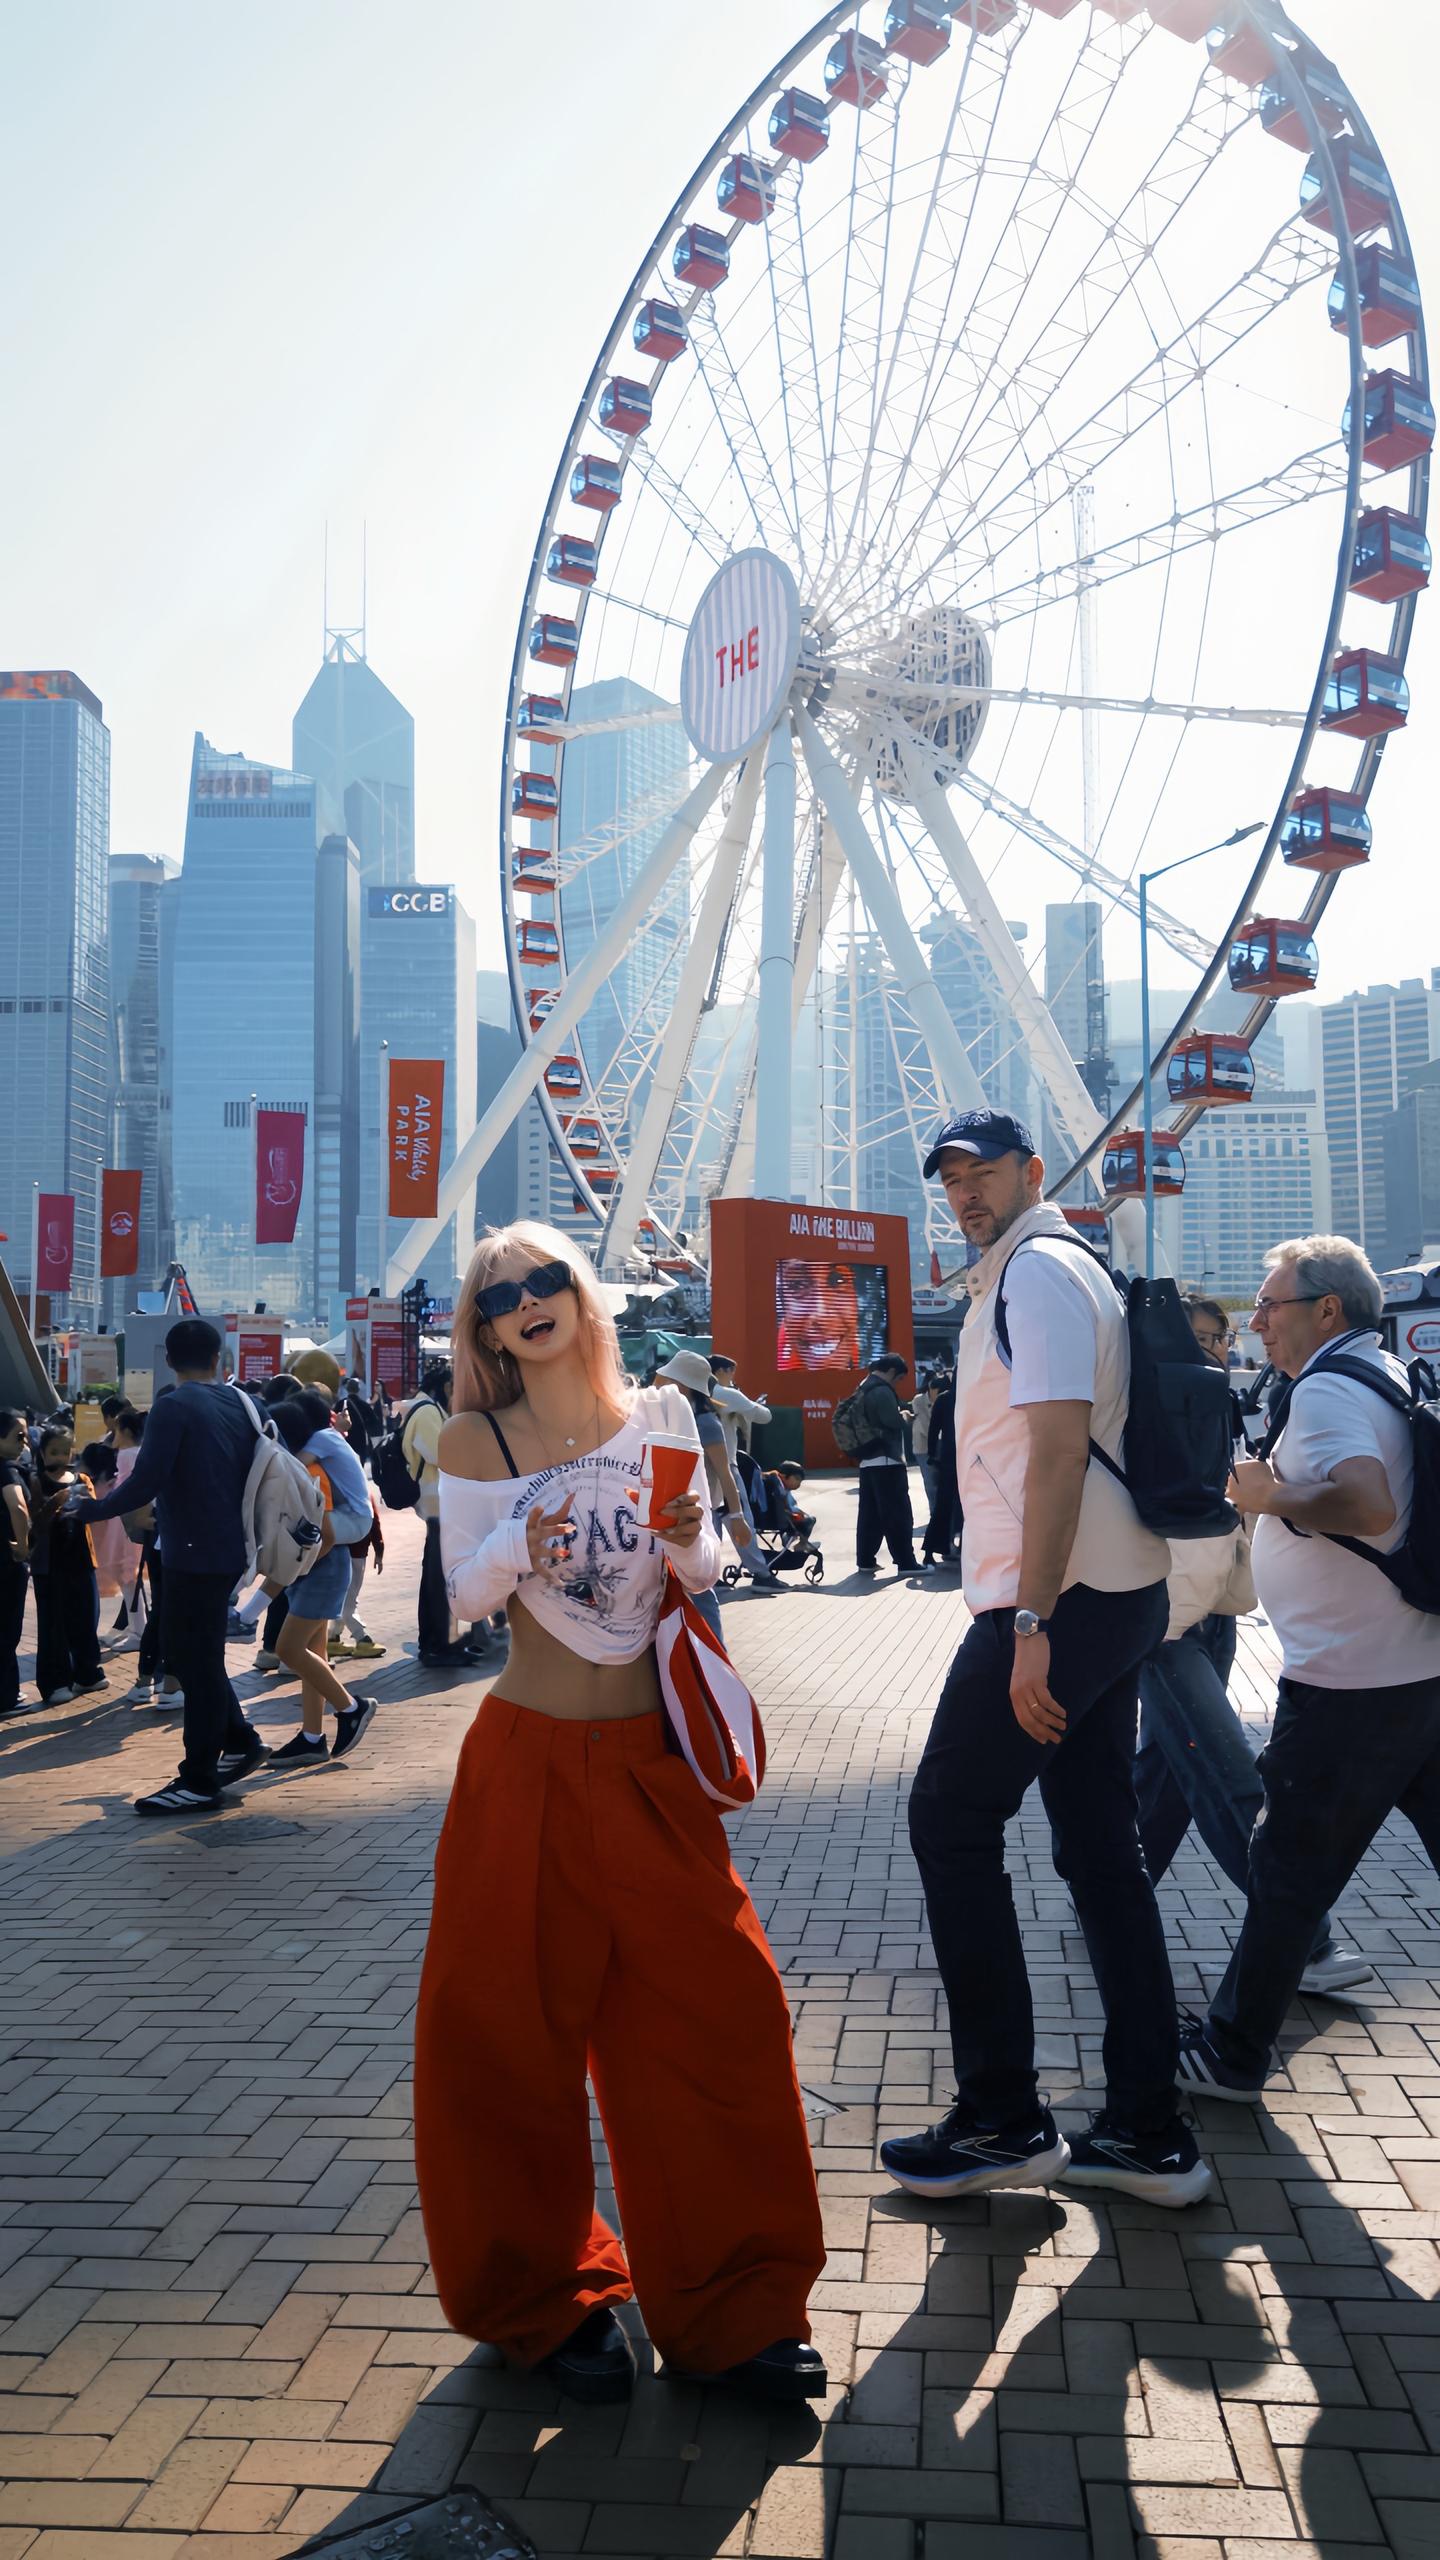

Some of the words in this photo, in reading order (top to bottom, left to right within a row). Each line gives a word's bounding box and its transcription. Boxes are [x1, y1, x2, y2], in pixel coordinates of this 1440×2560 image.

[715, 625, 759, 688] THE
[391, 893, 446, 912] CCB
[394, 1105, 410, 1161] PARK
[414, 1094, 431, 1133] AIA
[790, 1213, 810, 1236] AIA
